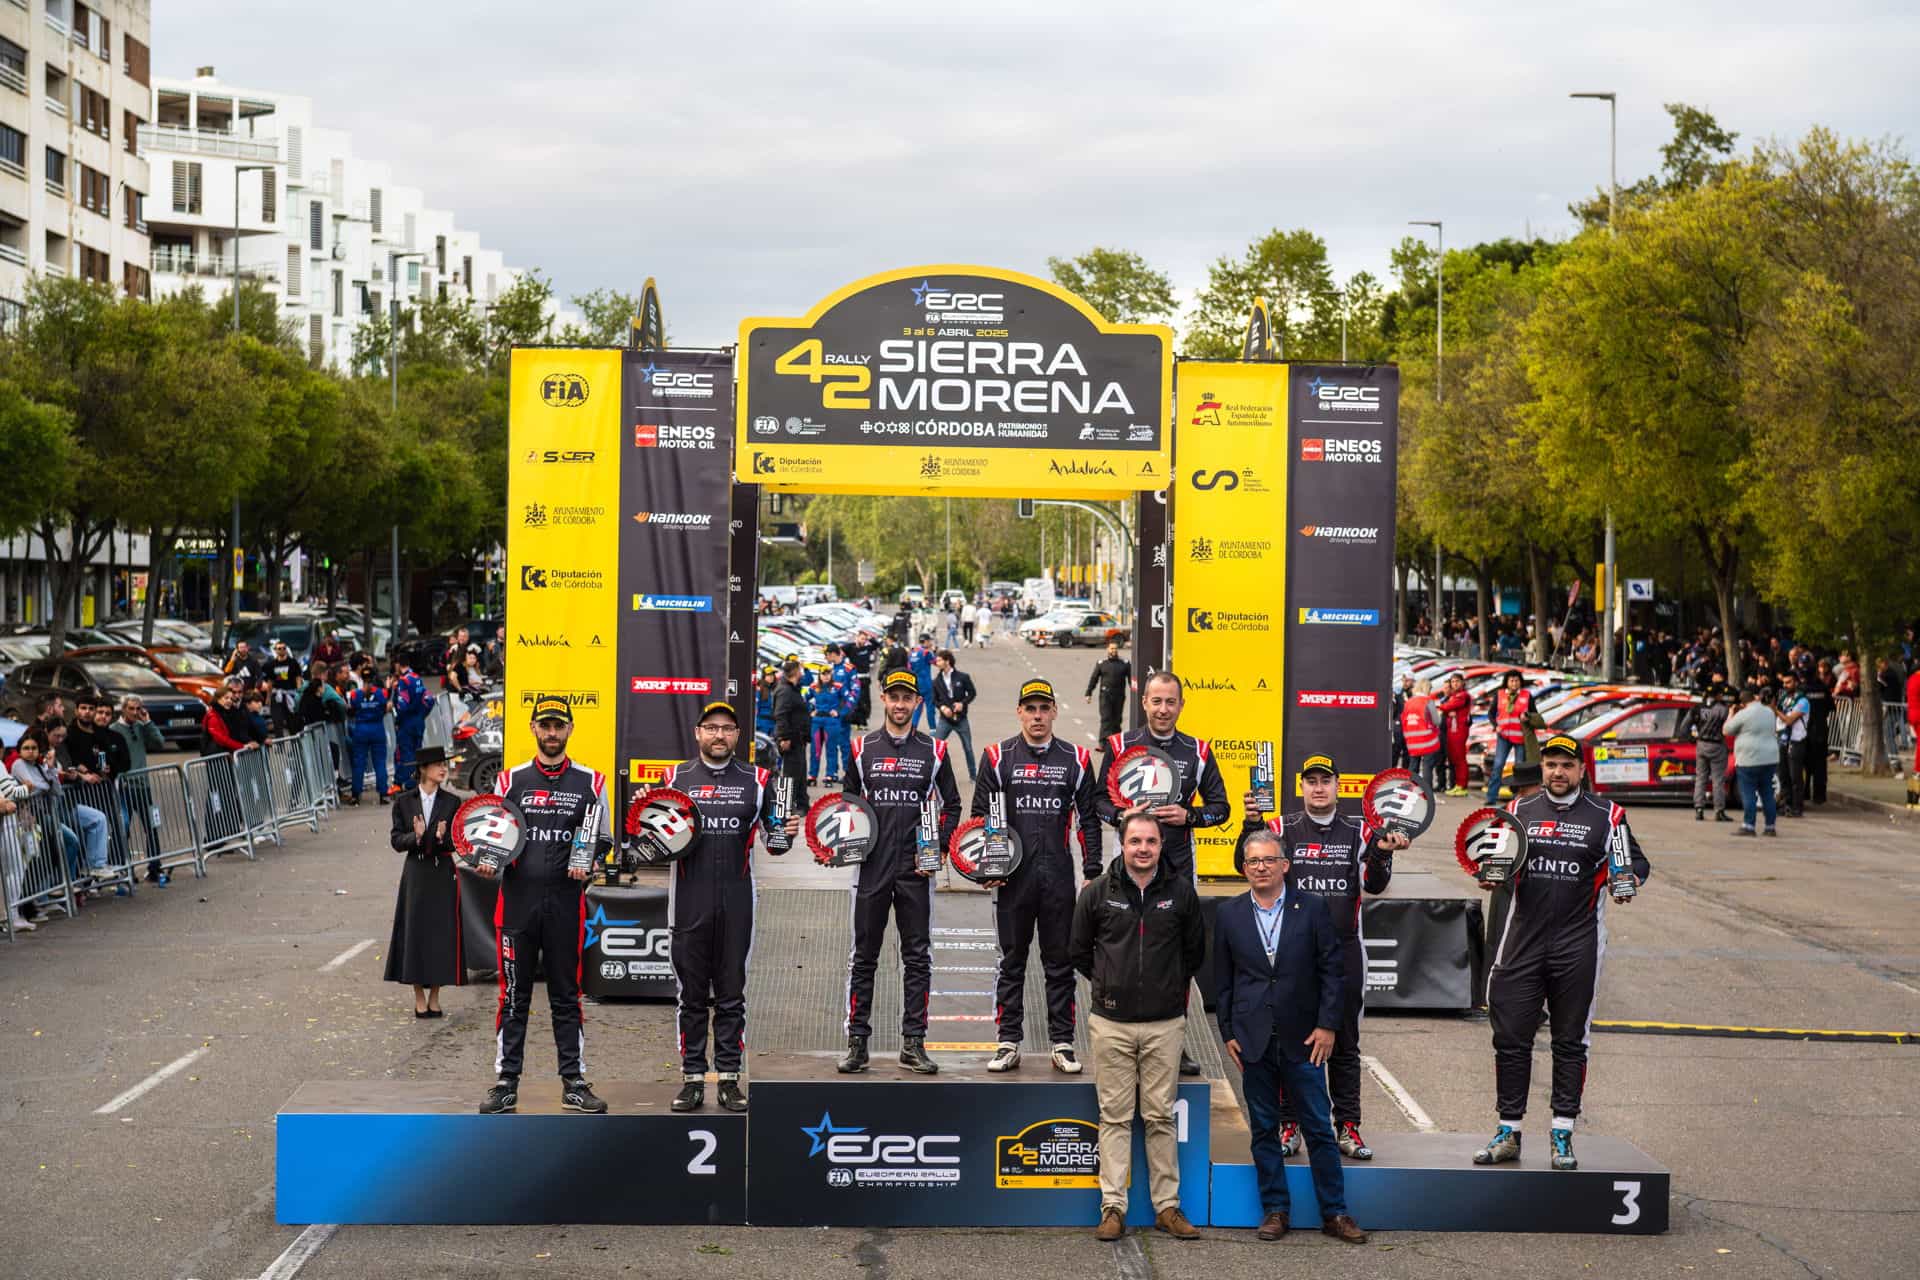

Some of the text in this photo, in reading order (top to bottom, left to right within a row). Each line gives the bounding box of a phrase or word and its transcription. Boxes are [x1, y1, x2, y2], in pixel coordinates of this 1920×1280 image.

[925, 293, 1004, 311] ERC
[903, 328, 1009, 337] 3 al 6 ABRIL 2025
[825, 354, 872, 367] RALLY
[879, 340, 1088, 377] SIERRA
[652, 373, 714, 388] ERC
[543, 381, 584, 400] FIA
[1319, 386, 1380, 401] ERC
[879, 378, 1136, 415] MORENA
[754, 418, 778, 433] FIA
[915, 419, 996, 437] CÓRDOBA
[659, 425, 716, 440] ENEOS
[998, 430, 1048, 438] HUMANIDAD
[659, 440, 716, 449] MOTOR OIL
[1325, 439, 1382, 453] ENEOS
[779, 457, 822, 467] Diputación
[1325, 453, 1382, 463] MOTOR OIL
[1050, 459, 1117, 478] Andalucía
[553, 506, 604, 516] AYUNTAMIENTO
[1219, 541, 1271, 550] AYUNTAMIENTO
[1219, 550, 1229, 559] DE
[551, 569, 602, 579] Diputación
[551, 579, 603, 589] de Córdoba
[655, 600, 705, 608] MICHELIN
[1217, 611, 1269, 622] Diputación
[1322, 613, 1373, 621] MICHELIN
[1217, 621, 1270, 631] de Córdoba
[634, 681, 708, 692] MRF TYRES
[1300, 694, 1375, 705] MRF TYRES
[872, 762, 895, 771] GR
[1013, 769, 1036, 777] GR
[689, 789, 713, 798] GR
[521, 795, 546, 807] GR
[1527, 826, 1553, 836] GR
[1295, 848, 1320, 857] GR
[601, 963, 626, 978] FIA
[1172, 1098, 1189, 1143] 1
[687, 1129, 718, 1175] 2
[827, 1135, 960, 1163] ERC
[828, 1169, 852, 1186] FIA
[1611, 1180, 1641, 1225] 3
